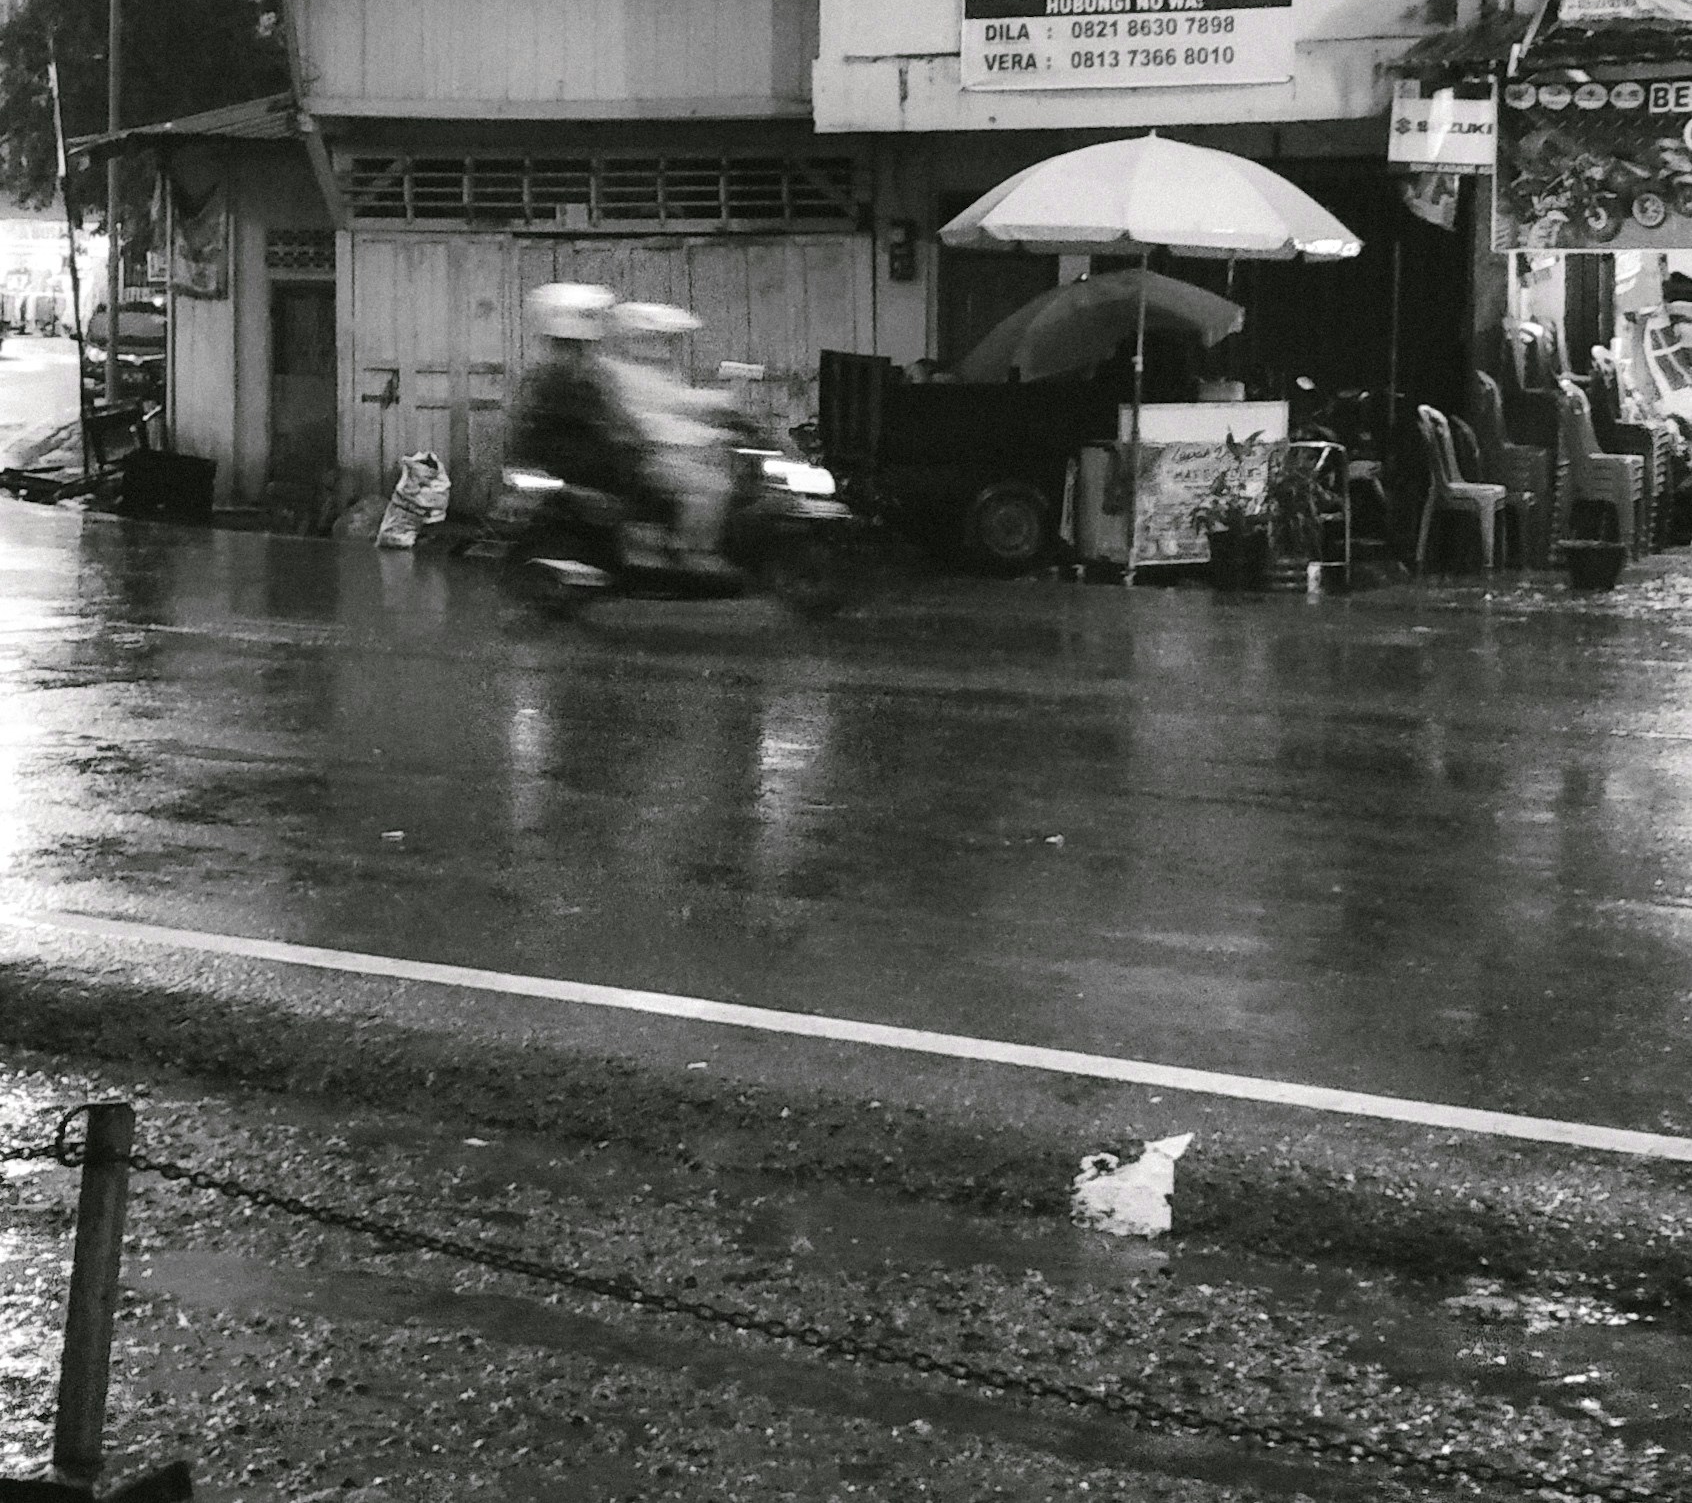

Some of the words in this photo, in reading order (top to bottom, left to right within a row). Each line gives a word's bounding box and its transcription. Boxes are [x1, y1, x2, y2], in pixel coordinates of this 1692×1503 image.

[985, 23, 1030, 41] DILA
[1046, 26, 1053, 40] :
[1071, 20, 1119, 39] 0821
[1127, 17, 1178, 37] 8630
[1184, 15, 1235, 34] 7898
[984, 52, 1038, 71] VERA
[1046, 56, 1053, 70] :
[1071, 50, 1120, 69] 0813
[1127, 48, 1177, 66] 7366
[1183, 45, 1235, 65] 8010
[1416, 120, 1494, 135] SZUKI
